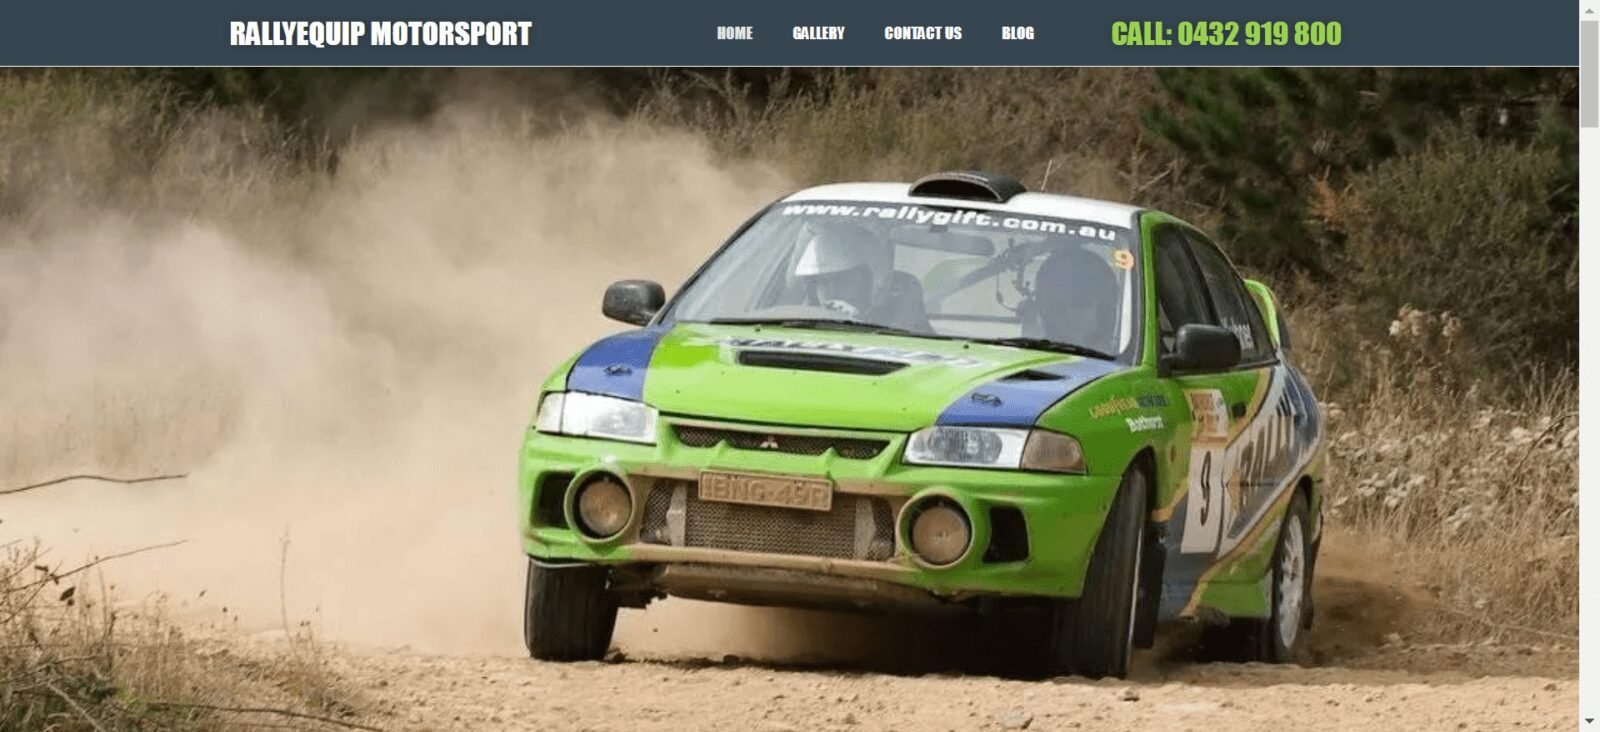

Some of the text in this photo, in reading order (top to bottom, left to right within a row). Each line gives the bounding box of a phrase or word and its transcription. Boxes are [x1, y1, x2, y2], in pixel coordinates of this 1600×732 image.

[782, 203, 1118, 242] www.rallygift.com.au
[1114, 249, 1135, 270] 9
[1200, 450, 1212, 527] 9
